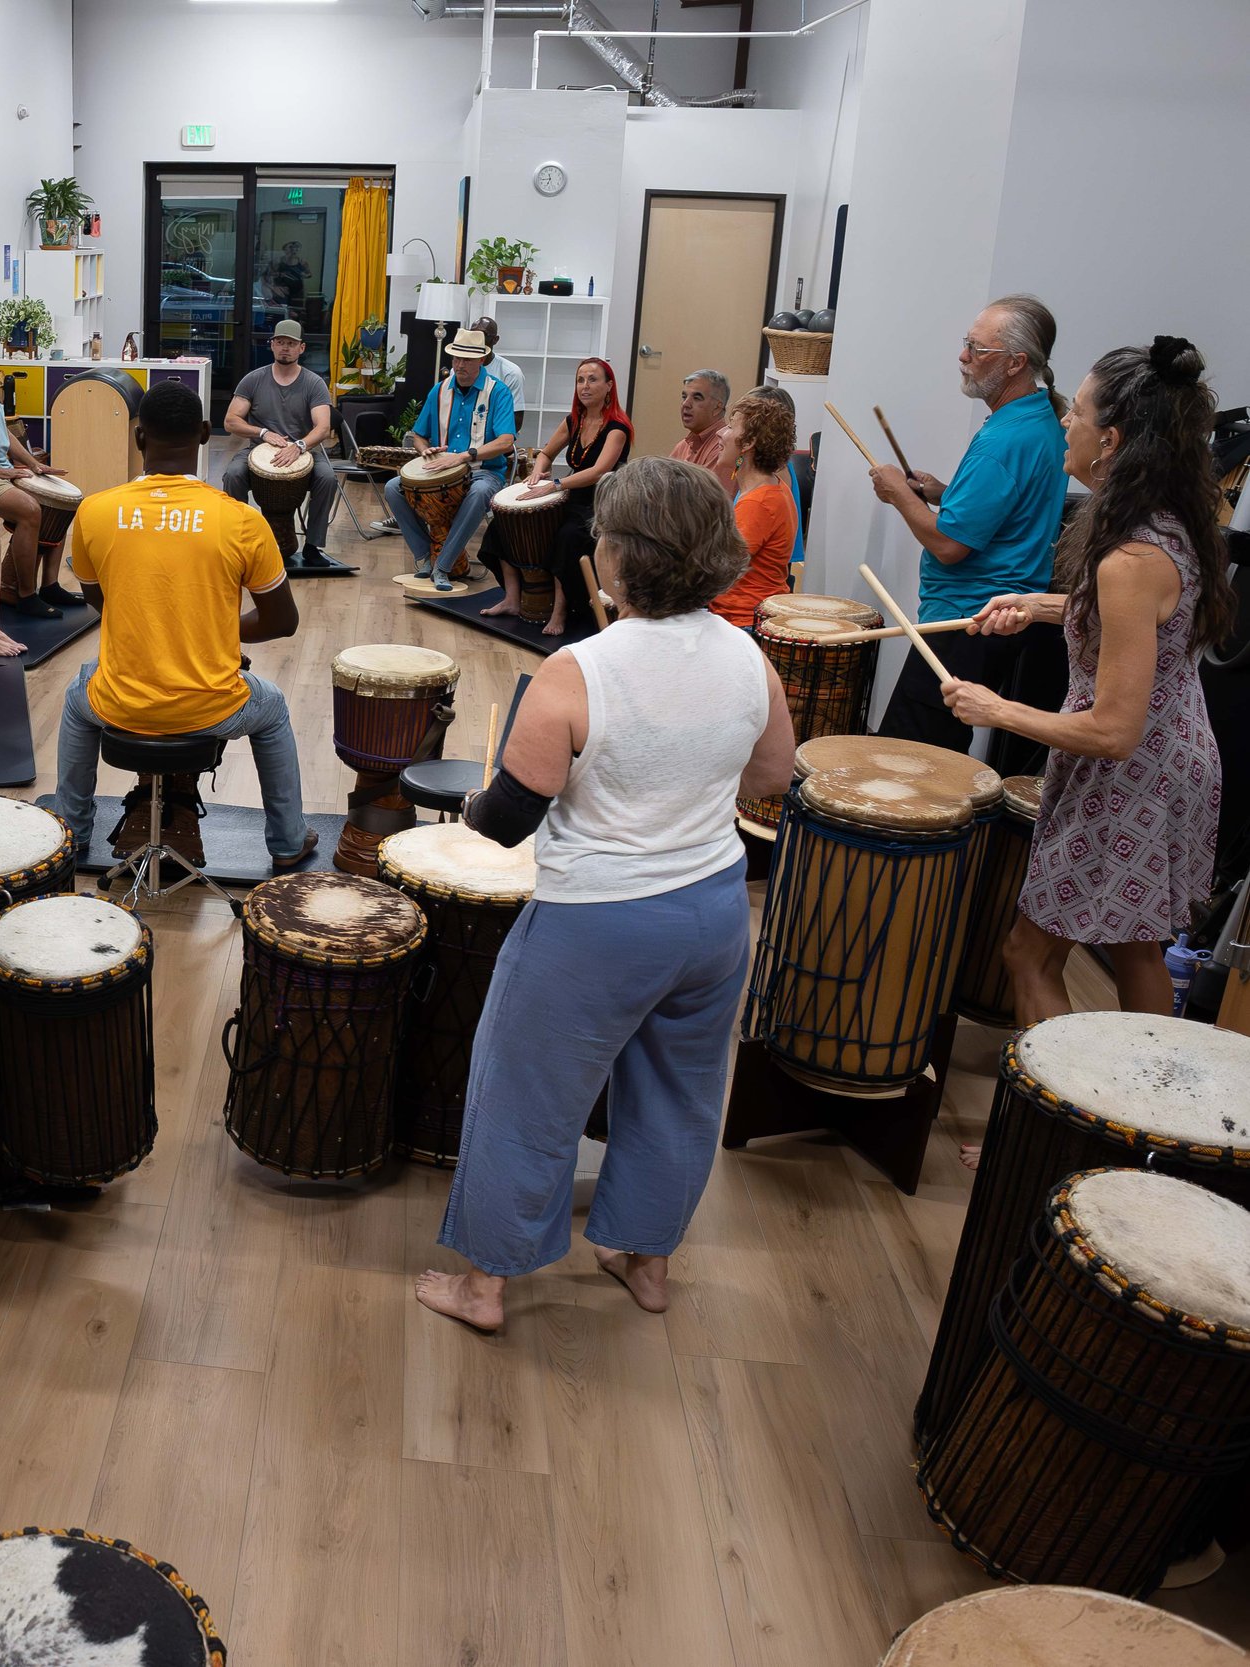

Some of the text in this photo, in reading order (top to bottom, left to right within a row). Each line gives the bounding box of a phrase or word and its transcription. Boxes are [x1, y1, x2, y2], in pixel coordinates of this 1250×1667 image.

[187, 126, 212, 144] EXIT
[118, 505, 205, 533] LA JOIE
